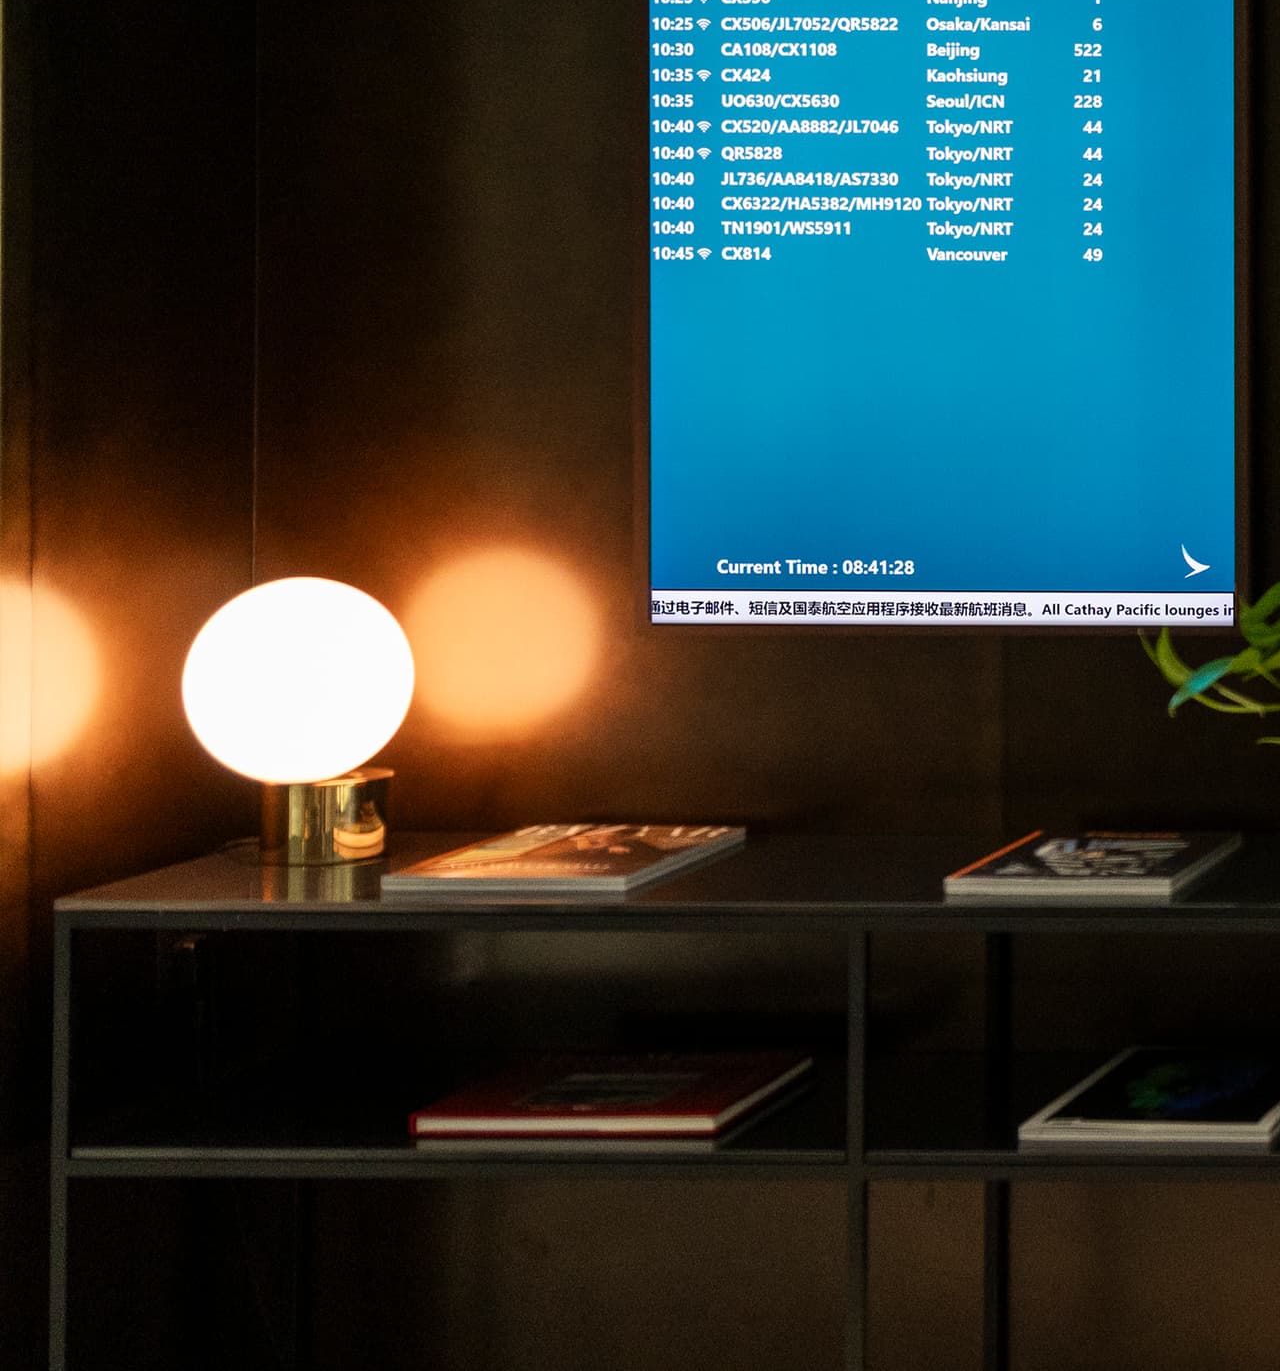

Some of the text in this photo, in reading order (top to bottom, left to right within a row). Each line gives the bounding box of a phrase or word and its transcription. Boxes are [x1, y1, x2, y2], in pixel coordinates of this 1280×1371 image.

[652, 17, 1102, 32] 10:25 CX506/JL7052/QR5822 Osaka/Kansai 6
[652, 42, 1102, 60] 10:30 CA108/CX1108 Beijing 522
[653, 68, 1100, 86] 10:35 CX424 Kaohsiung 21
[652, 94, 1102, 109] 10:35 UO630/CX5630 Seoul/ICN 228
[653, 119, 1102, 137] 10:40 CX520/AA8882/JL7046 Tokyo/NRT 44
[653, 146, 1103, 164] 10:40 QR5828 Tokyo/NRT 44
[653, 172, 1103, 190] 10:40 JL736/AA8418/AS7330 Tokyo/NRT 24
[653, 196, 1103, 214] 10:40 CX6322/HA5382/MH9120 Tokyo/NRT 24
[653, 221, 1103, 239] 10:40 TN1901/WS5911 Tokyo/NRT 24
[653, 247, 1103, 261] 10:45 CX814 Vancouver 49
[716, 558, 782, 576] Current
[784, 558, 829, 576] Time
[842, 558, 915, 576] 08:41:28
[1042, 603, 1060, 616] All
[1063, 603, 1112, 619] Cathay
[1116, 603, 1161, 617] Pacific
[1165, 604, 1220, 620] lounges
